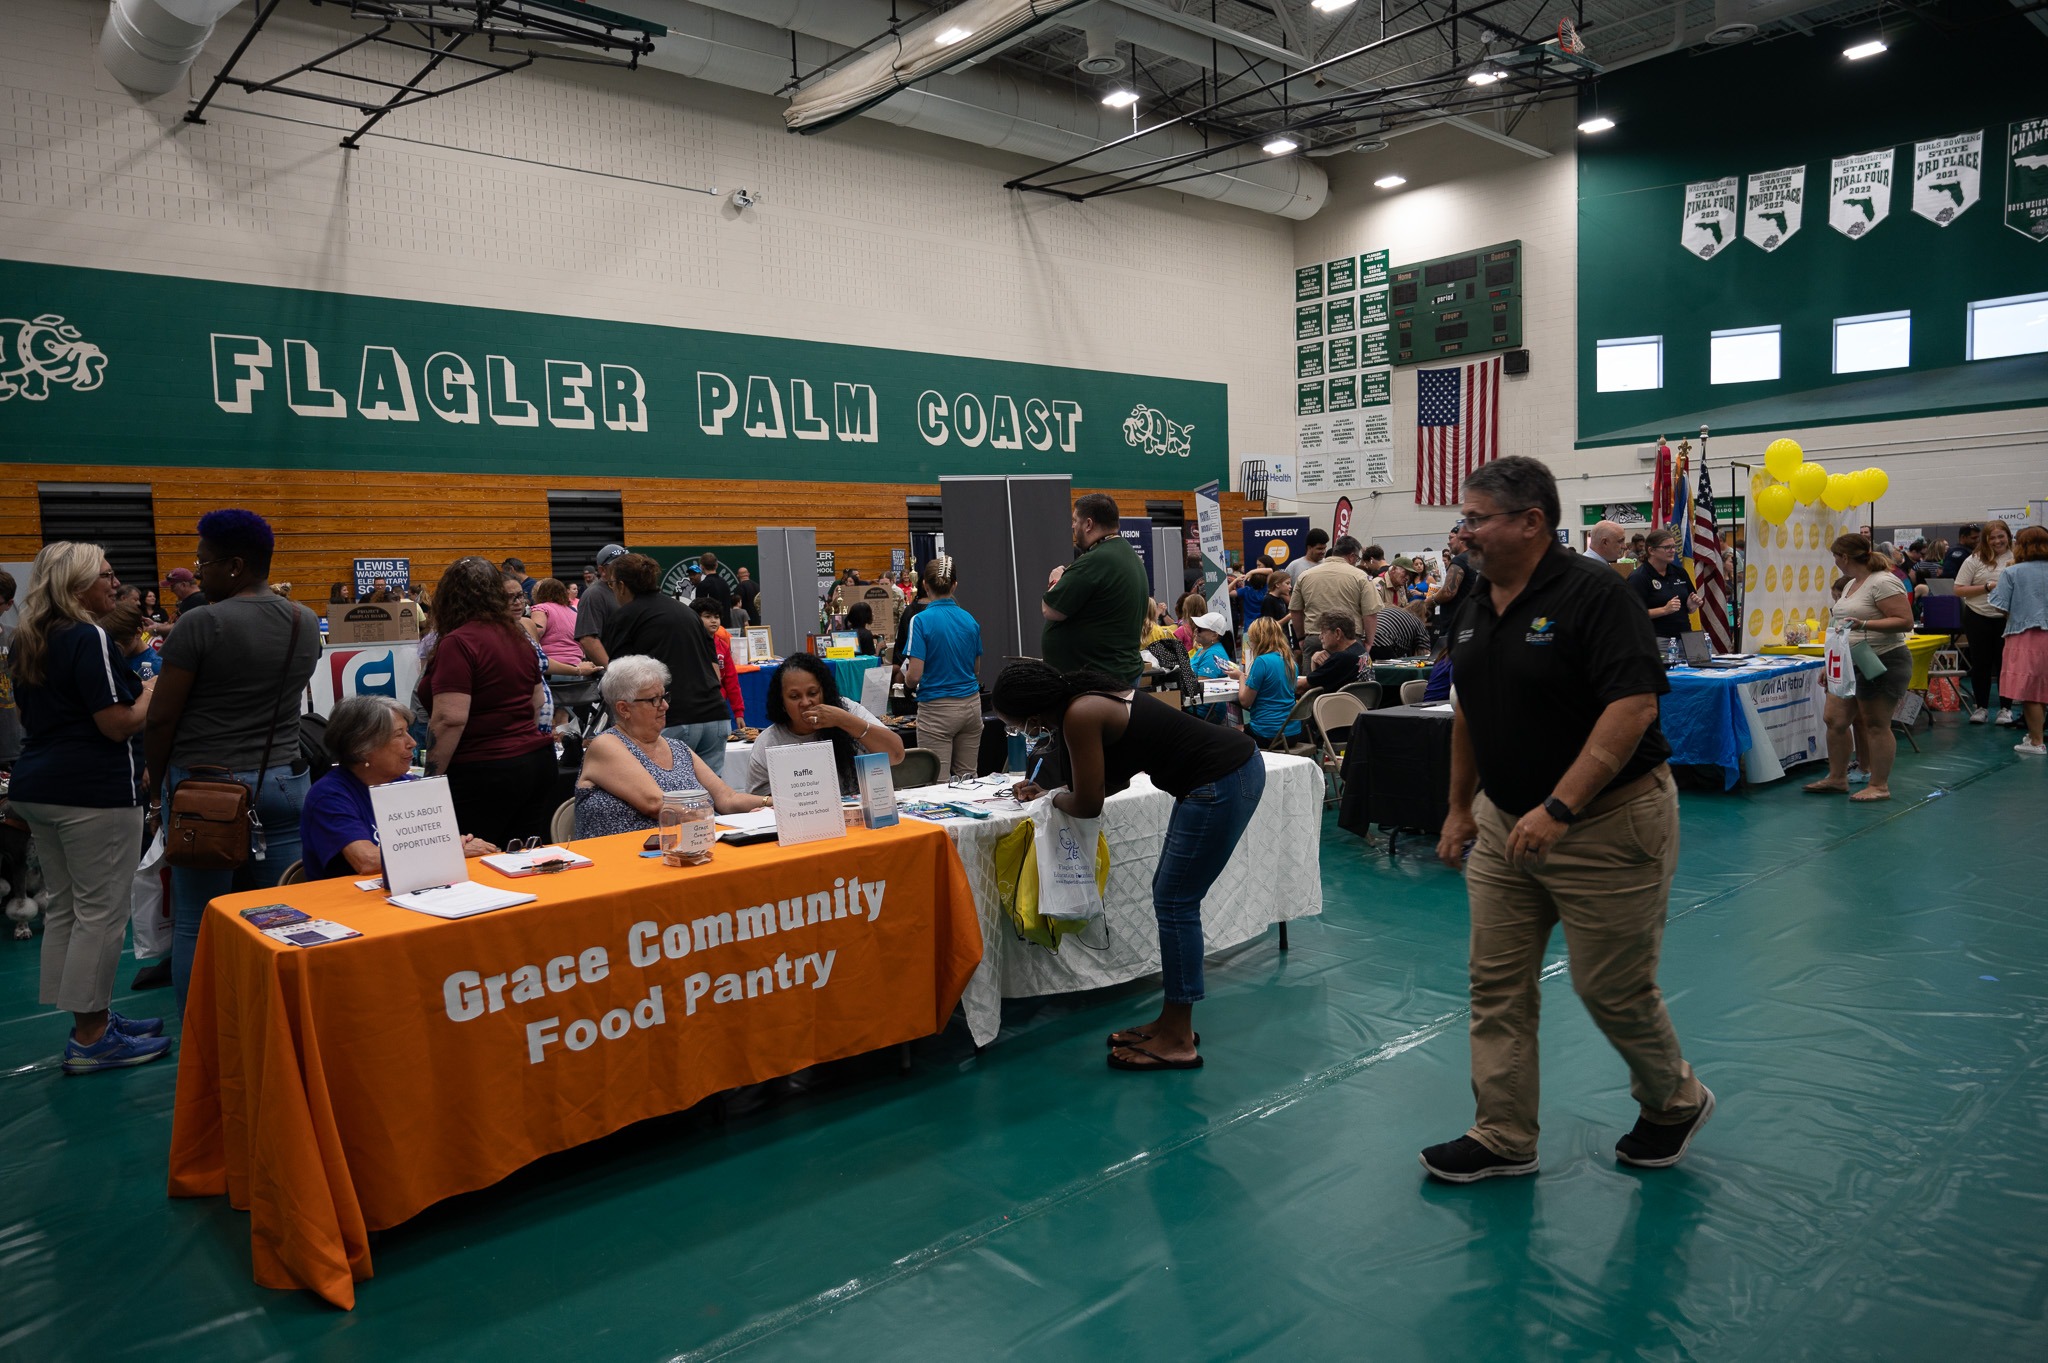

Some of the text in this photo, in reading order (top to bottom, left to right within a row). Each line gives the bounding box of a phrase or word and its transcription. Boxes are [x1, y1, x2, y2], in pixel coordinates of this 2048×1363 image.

[1944, 134, 1981, 147] BOWLING
[1928, 144, 1968, 158] STATE
[1843, 162, 1881, 174] STATE
[1917, 152, 1979, 180] 3RD PLACE
[1936, 170, 1958, 179] 2021
[1759, 182, 1791, 193] STATE
[1833, 169, 1889, 197] FINAL FOUR
[1695, 188, 1727, 199] STATE
[1849, 185, 1871, 194] 2022
[1749, 188, 1801, 210] THIRD PLACE
[1685, 195, 1735, 219] FINAL FOUR
[1764, 201, 1784, 210] 2022
[1701, 211, 1719, 219] 2022
[1436, 293, 1454, 304] period
[210, 332, 1083, 453] FLAGLER PALM COAST
[1120, 530, 1140, 538] VISION
[1254, 528, 1299, 537] STRATEGY
[356, 561, 407, 571] LEWIS E.
[356, 570, 408, 578] WADSWORTH
[1776, 677, 1787, 694] Air
[793, 768, 813, 777] Raffle
[388, 805, 443, 822] ASK US ABOUT
[395, 821, 442, 836] VOLUNTEER
[392, 834, 451, 852] OPPORTUNITES
[442, 876, 886, 1023] Grace Community
[526, 949, 838, 1065] Food Pantry
